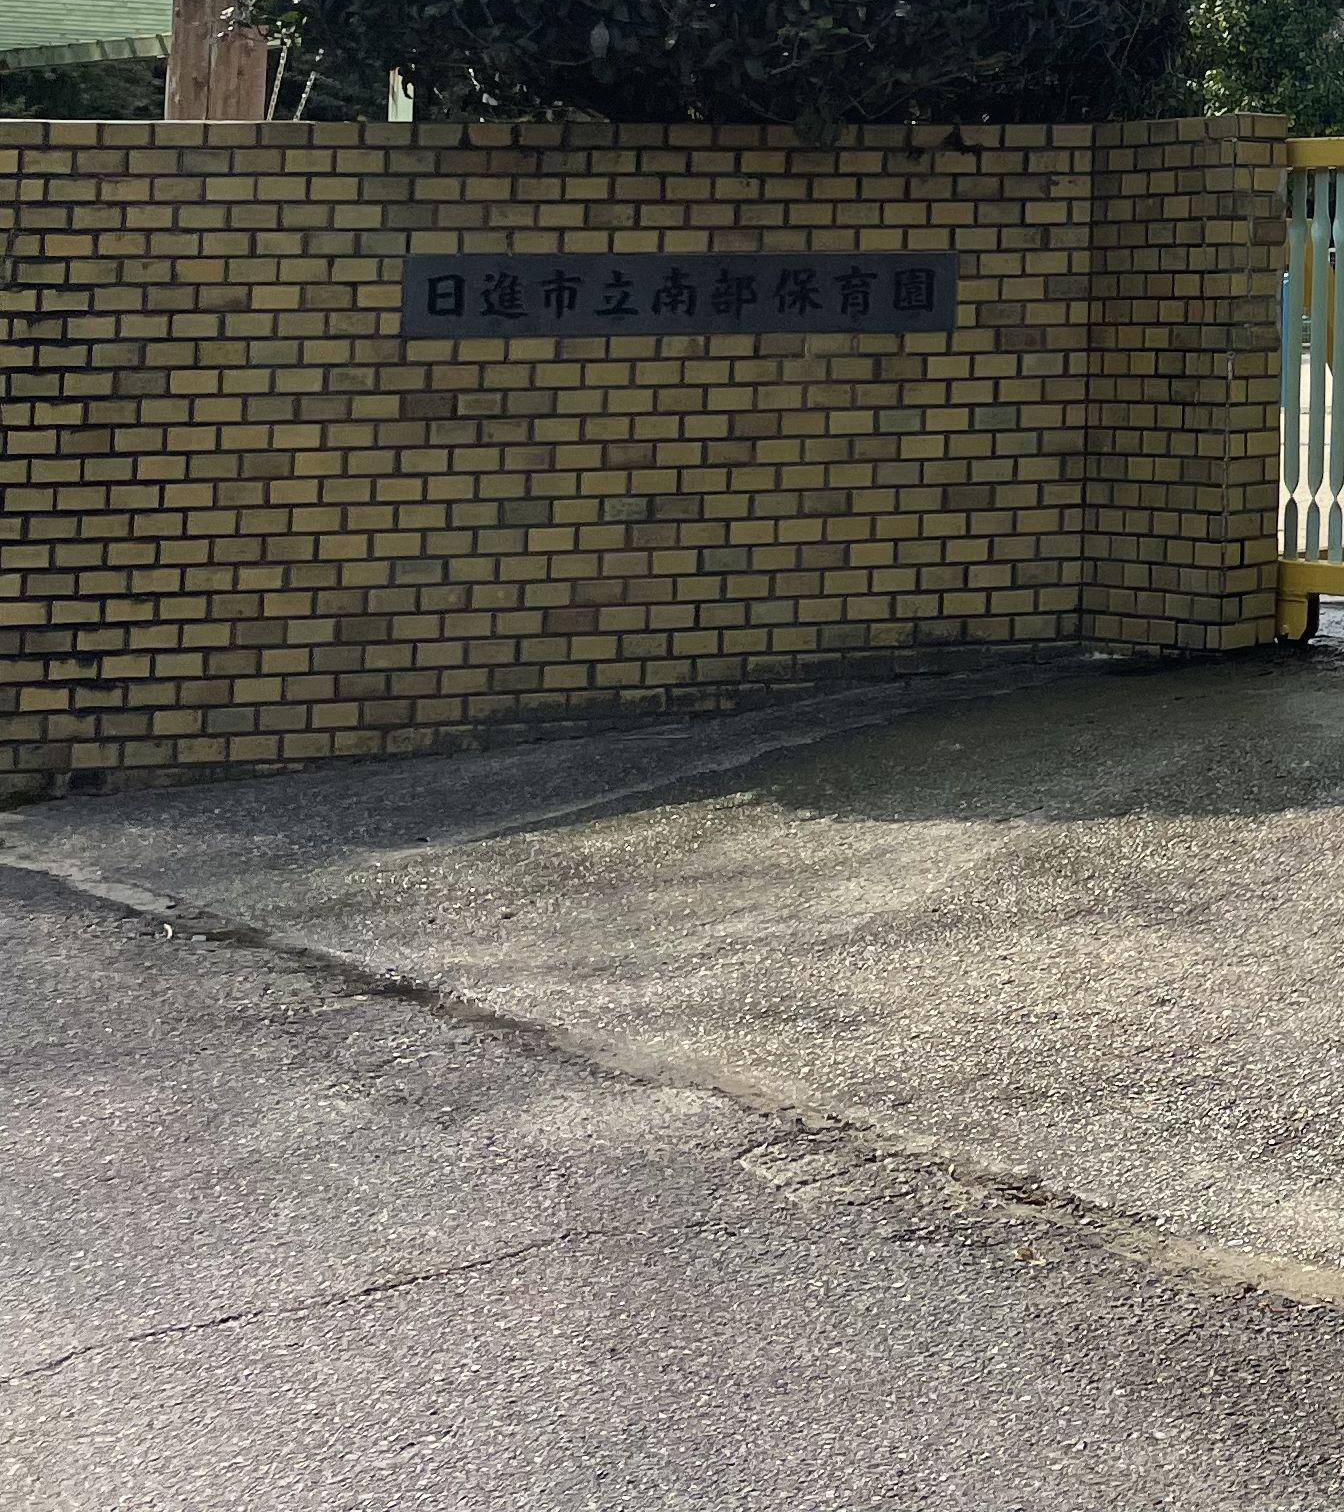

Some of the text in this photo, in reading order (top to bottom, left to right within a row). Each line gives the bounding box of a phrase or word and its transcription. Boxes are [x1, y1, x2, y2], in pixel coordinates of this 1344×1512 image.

[426, 266, 936, 320] 日進市立南部保育園
